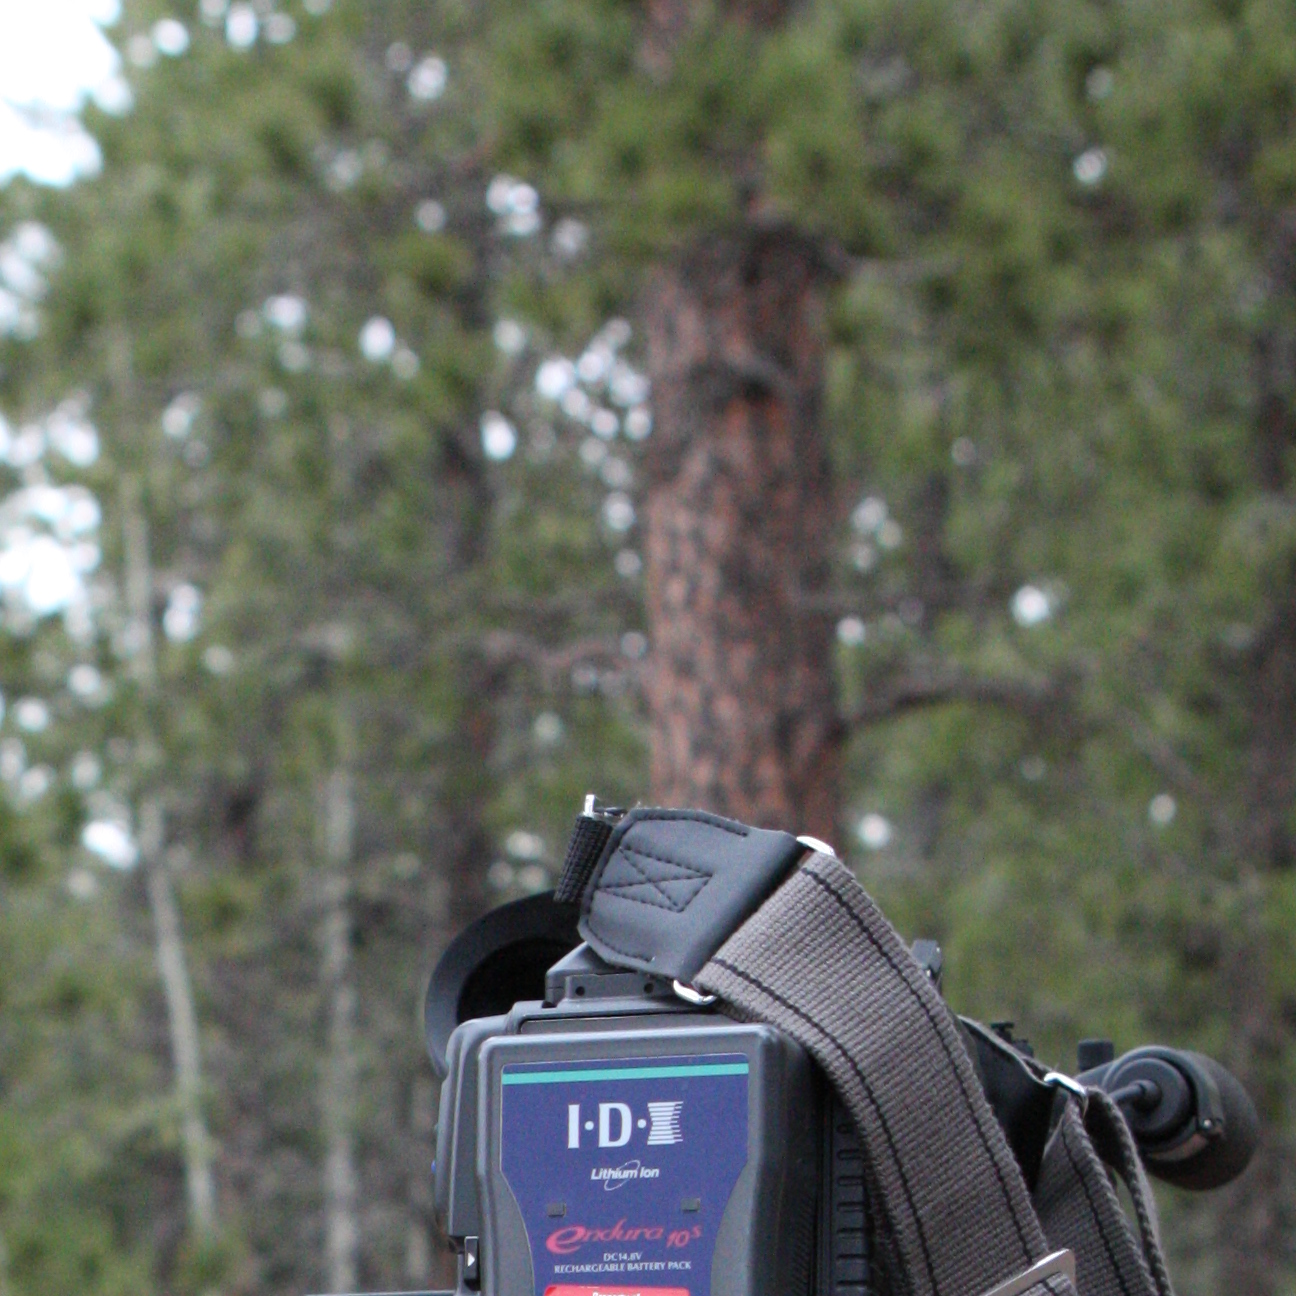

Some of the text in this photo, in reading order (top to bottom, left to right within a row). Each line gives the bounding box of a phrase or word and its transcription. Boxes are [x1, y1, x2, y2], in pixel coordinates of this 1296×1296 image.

[590, 1166, 660, 1181] Lithium Ion
[554, 1260, 692, 1274] RECHARGEABLE BATTERY PACK
